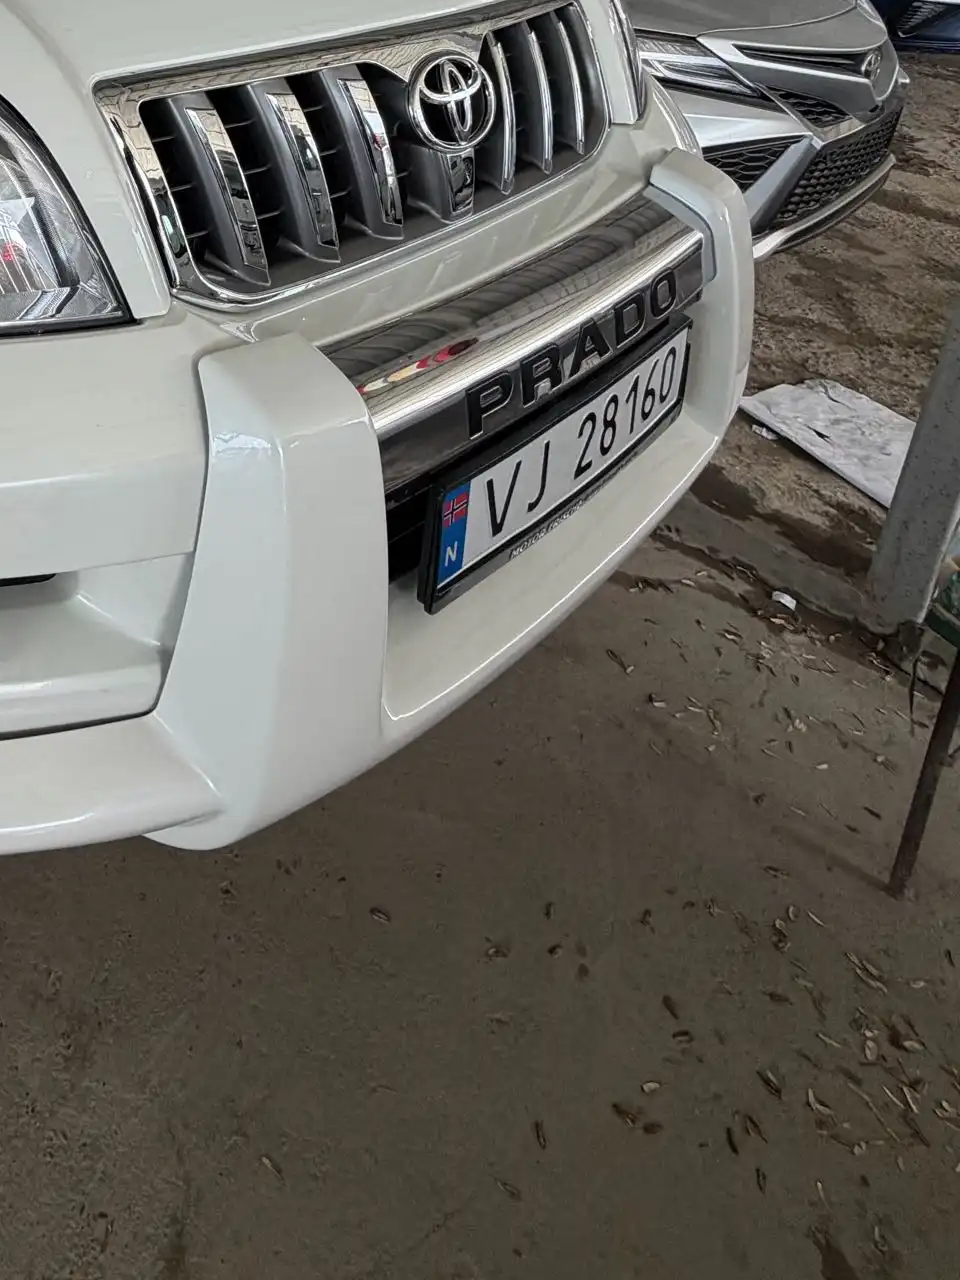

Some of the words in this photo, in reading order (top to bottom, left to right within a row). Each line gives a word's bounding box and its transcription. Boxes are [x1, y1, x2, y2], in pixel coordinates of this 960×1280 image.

[465, 270, 677, 440] PRADO
[486, 440, 550, 538] VJ
[573, 345, 677, 480] 28160
[444, 540, 458, 568] N
